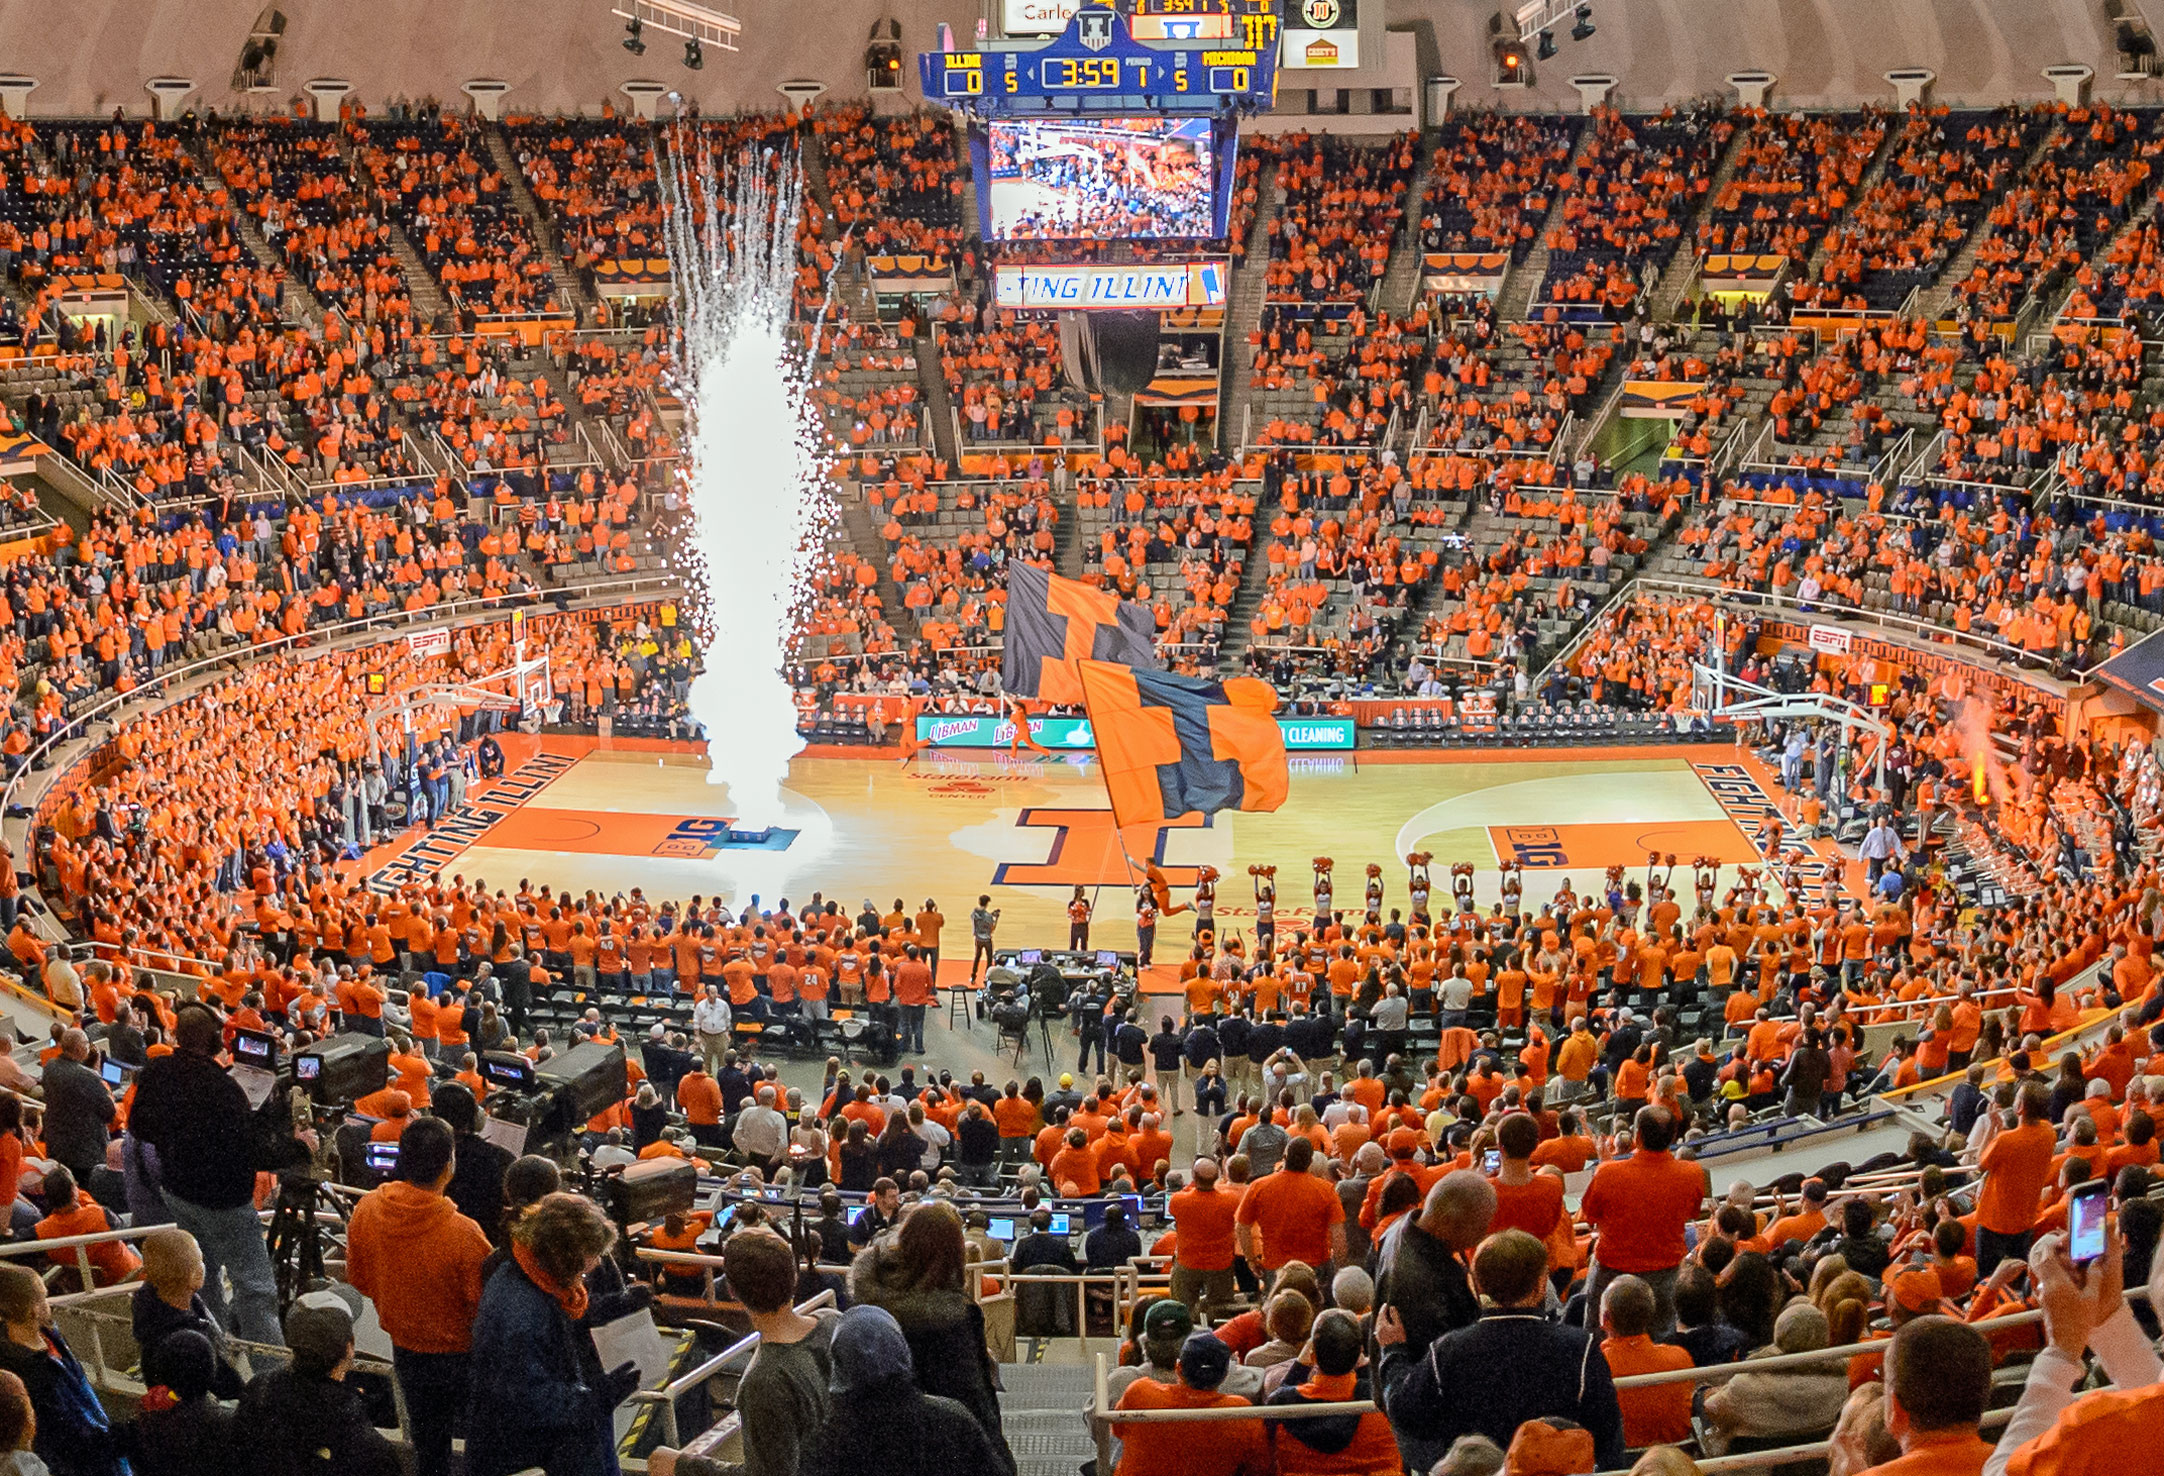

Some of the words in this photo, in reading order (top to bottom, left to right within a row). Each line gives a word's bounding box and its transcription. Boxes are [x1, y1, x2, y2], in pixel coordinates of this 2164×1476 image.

[1024, 4, 1072, 20] Carle
[967, 70, 982, 93] 0
[1004, 71, 1018, 93] 5
[1062, 59, 1118, 87] 3:59
[1139, 66, 1147, 88] 1
[1174, 70, 1188, 92] 5
[1233, 67, 1247, 92] 0
[1092, 275, 1187, 299] ILLINI
[412, 632, 447, 649] ESPN
[1813, 629, 1847, 648] ESPN
[930, 719, 979, 741] LIBMAN
[994, 720, 1043, 744] LIBAN
[1288, 726, 1345, 743] CLEANING
[369, 806, 507, 895] IGHTING
[478, 752, 579, 807] ILLINI
[804, 973, 818, 985] 24
